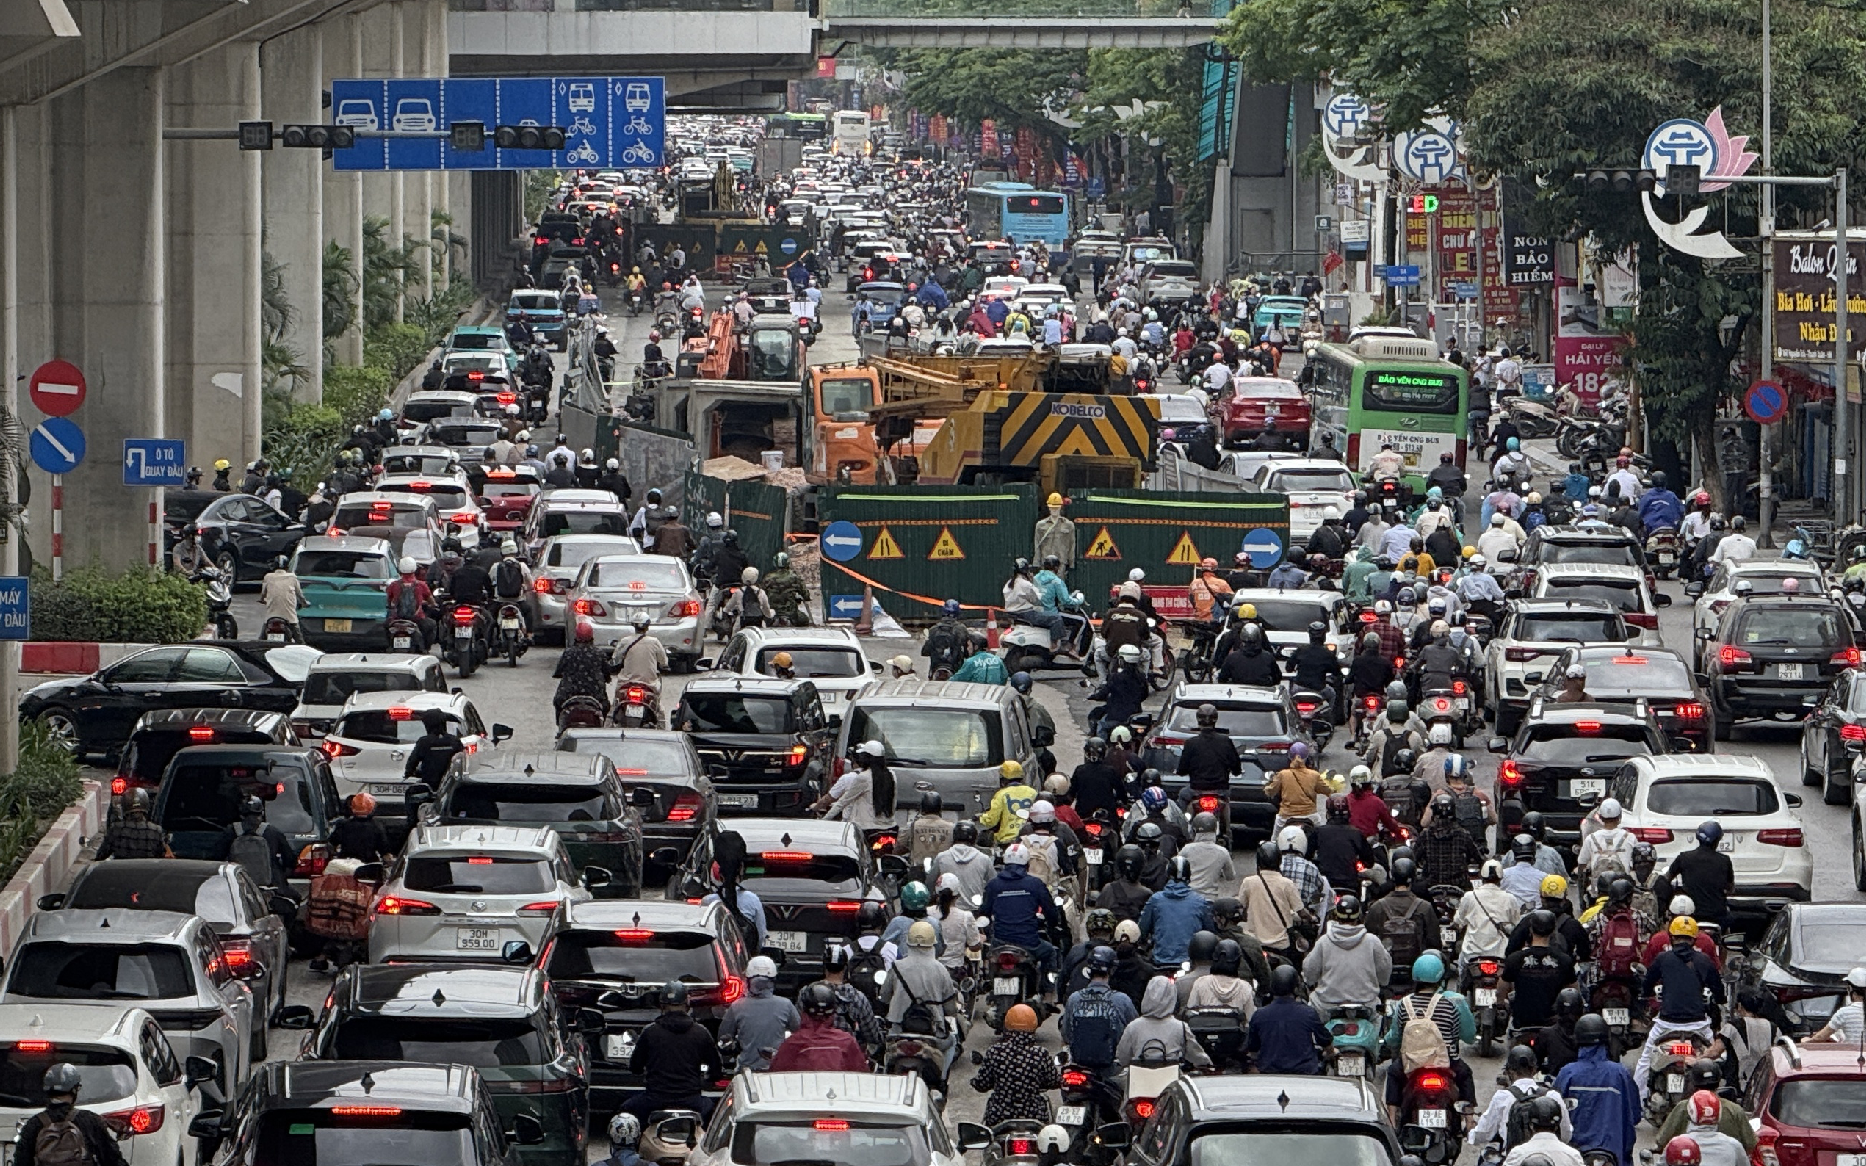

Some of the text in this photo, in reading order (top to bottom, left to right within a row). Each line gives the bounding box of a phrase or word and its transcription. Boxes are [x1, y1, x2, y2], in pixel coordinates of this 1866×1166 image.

[1515, 250, 1549, 265] BẢO
[1790, 242, 1824, 274] Balon
[1511, 265, 1554, 283] HIỂM
[1777, 292, 1794, 312] Bia
[1796, 292, 1813, 312] Hơi
[1799, 322, 1827, 347] Nhậu
[1565, 351, 1623, 365] HẢI YẾN
[1052, 402, 1104, 418] KOBELCO
[156, 448, 174, 460] Ô TÔ
[145, 462, 184, 477] QUAY ĐẦU
[0, 587, 21, 605] MÁY
[4, 608, 26, 628] ĐẦU
[469, 929, 488, 939] 30H
